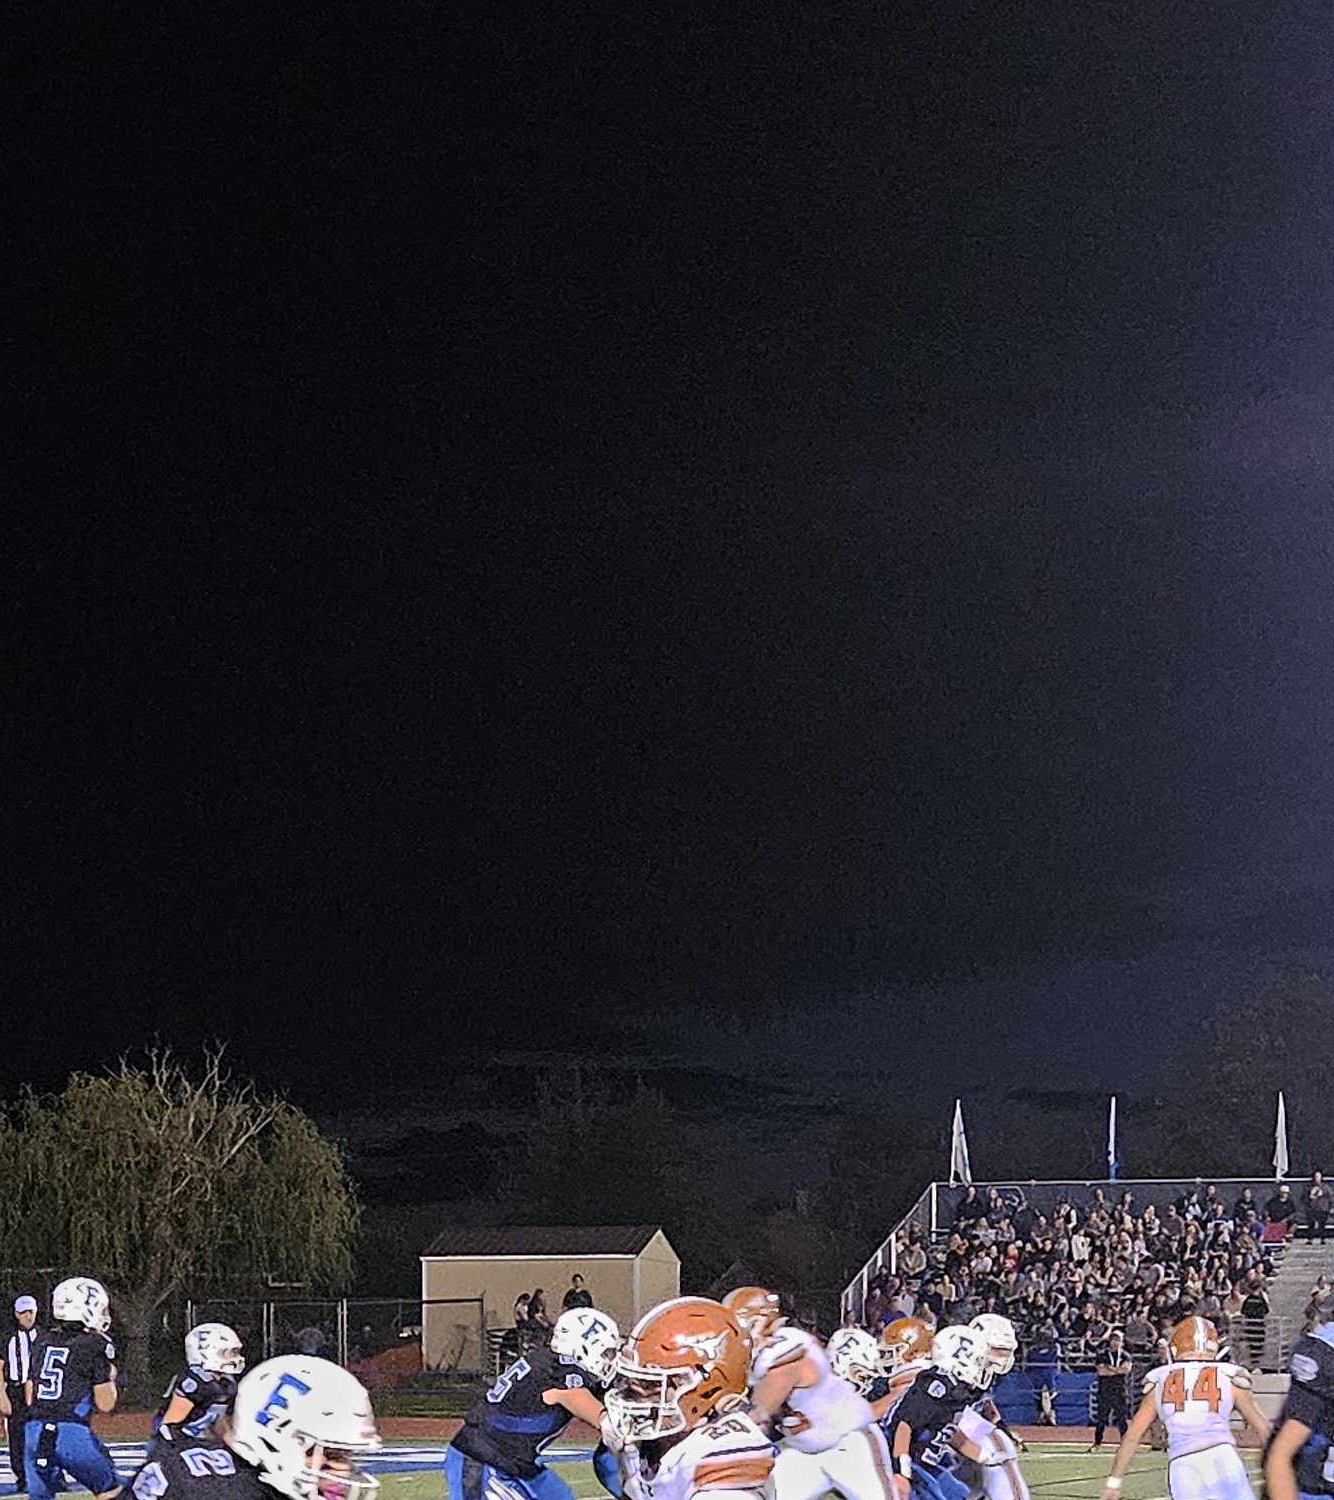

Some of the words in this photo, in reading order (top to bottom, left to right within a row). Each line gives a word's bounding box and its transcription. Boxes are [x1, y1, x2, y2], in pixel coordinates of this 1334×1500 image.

[36, 1345, 70, 1400] 5
[1162, 1366, 1222, 1413] 44
[180, 1448, 237, 1478] 2
